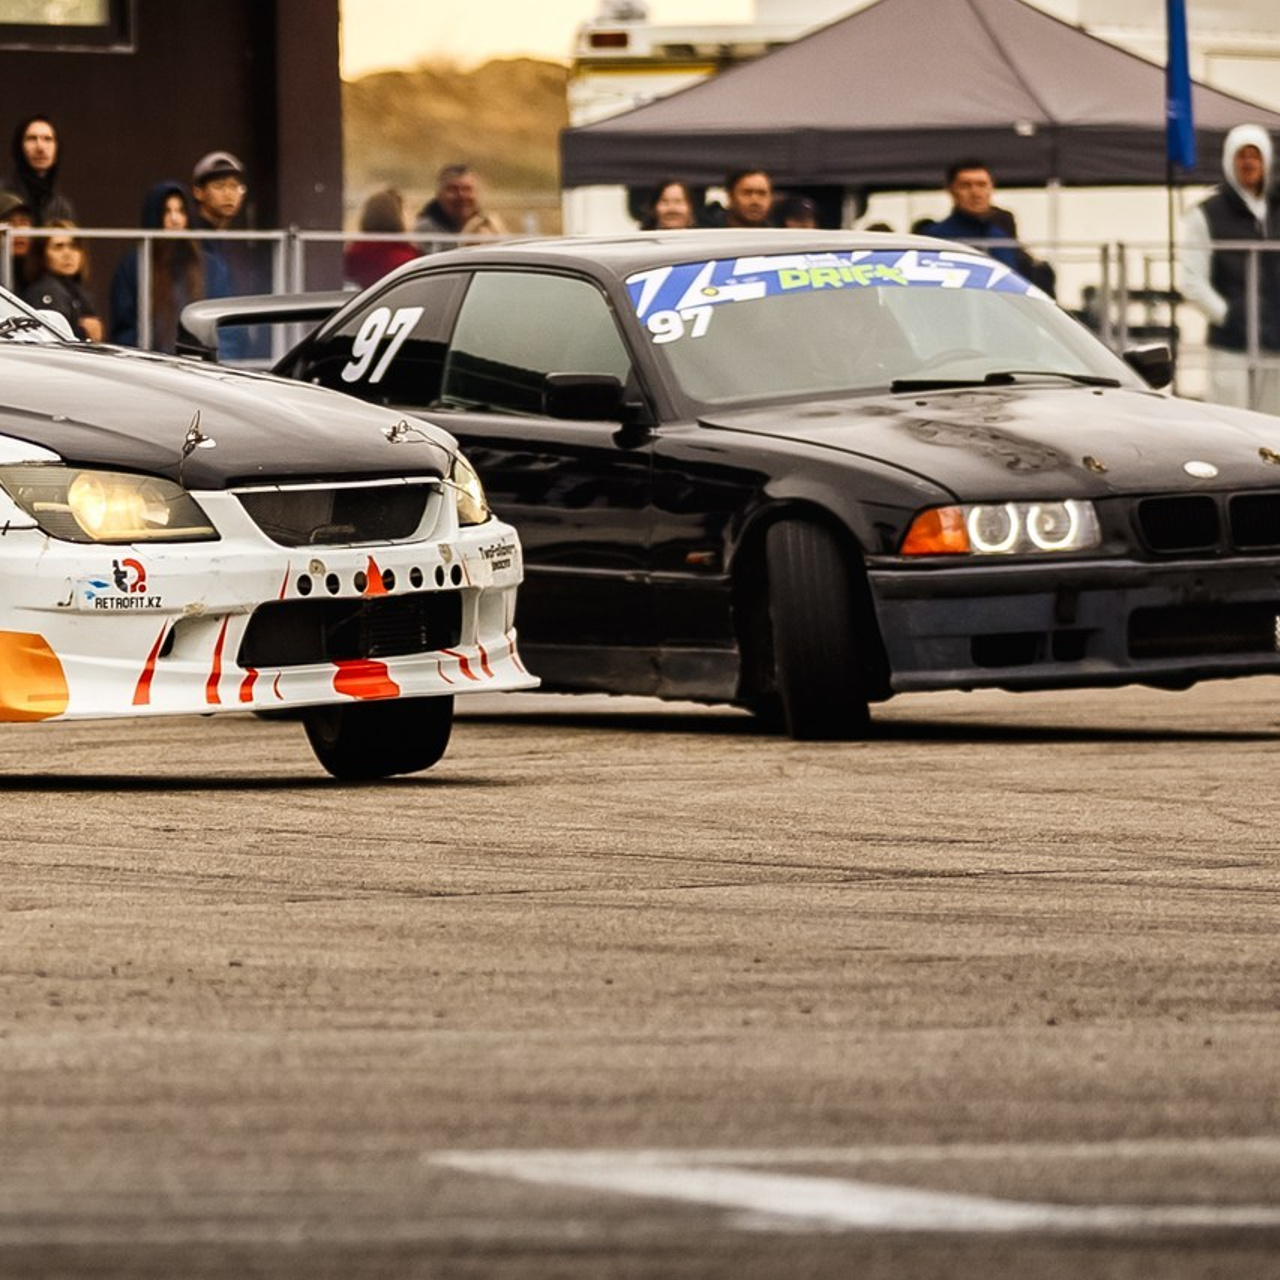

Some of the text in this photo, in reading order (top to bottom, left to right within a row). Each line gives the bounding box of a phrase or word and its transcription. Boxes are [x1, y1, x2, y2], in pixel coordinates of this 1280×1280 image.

[646, 305, 715, 344] 97
[340, 306, 425, 383] 97
[95, 596, 163, 609] RETROFIT.KZ
